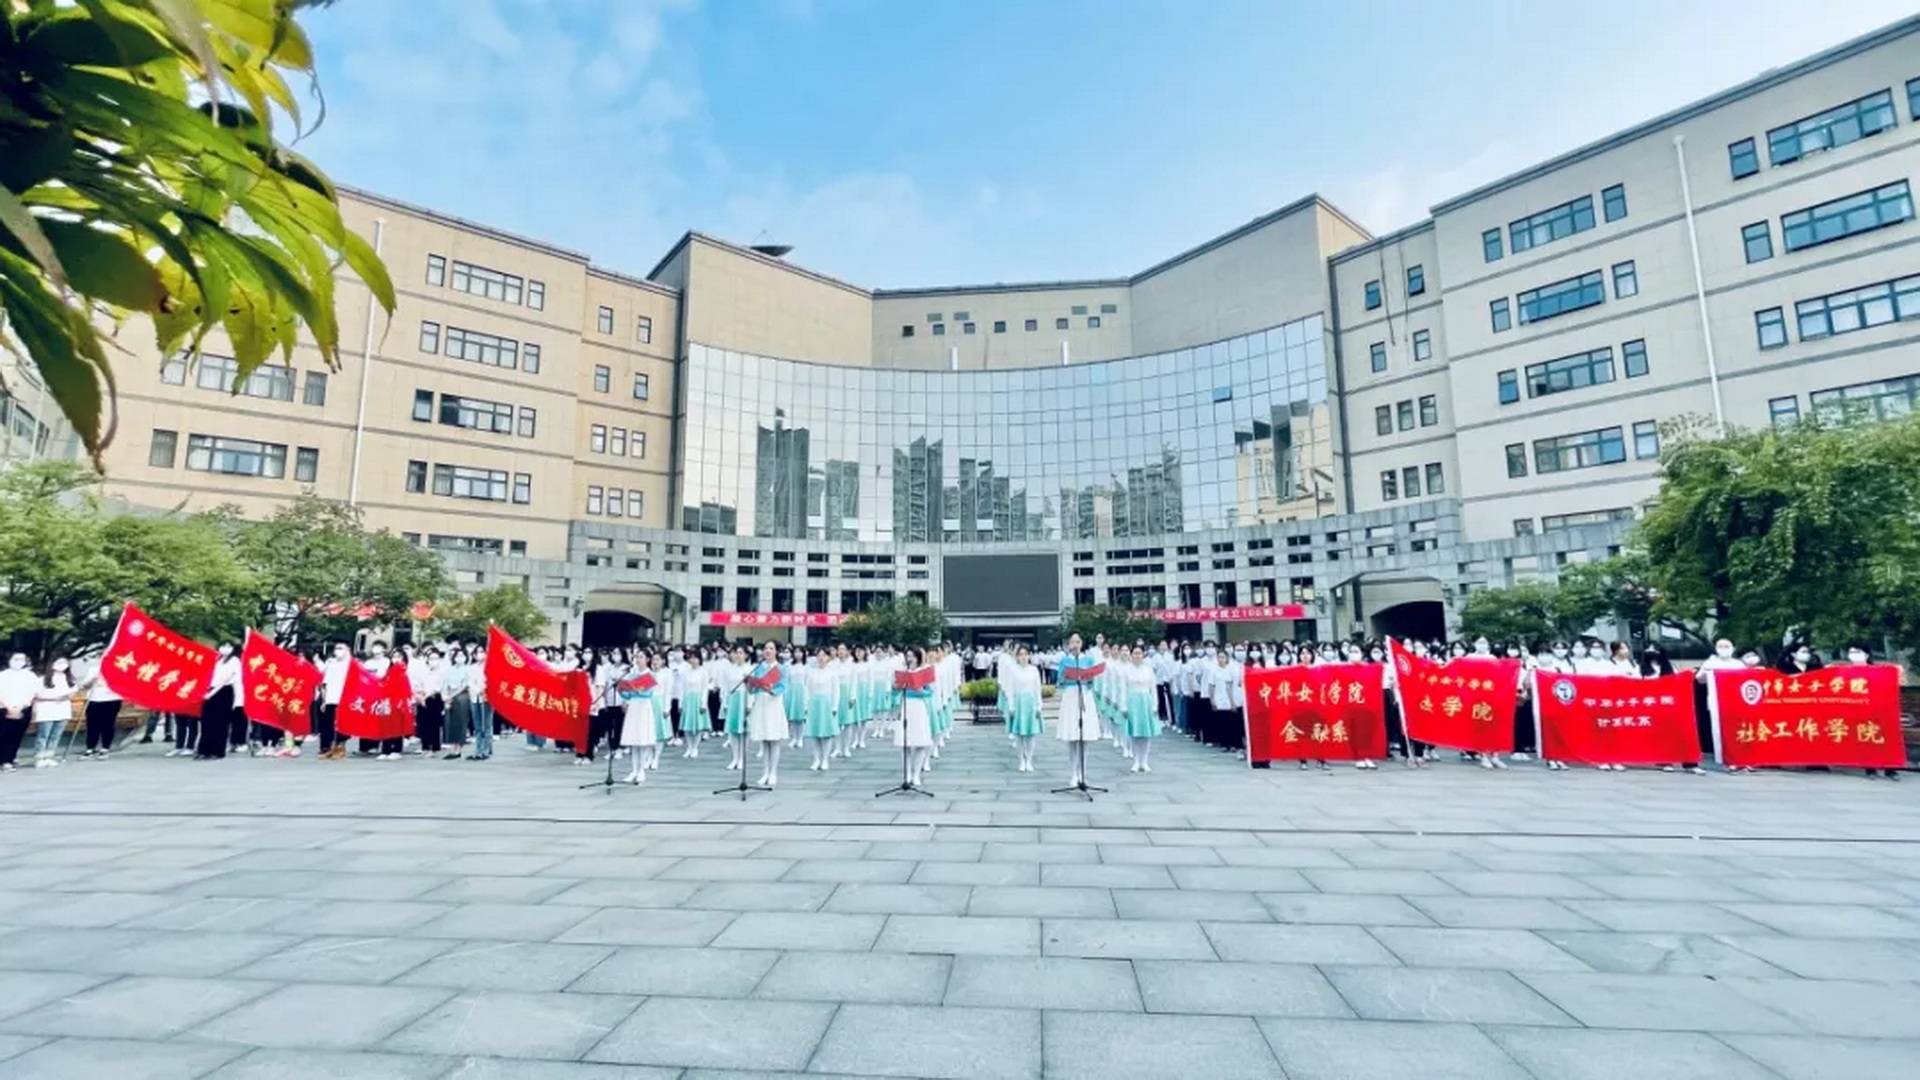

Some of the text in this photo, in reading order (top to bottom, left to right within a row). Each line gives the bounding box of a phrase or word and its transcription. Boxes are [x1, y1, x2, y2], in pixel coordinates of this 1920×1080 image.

[1280, 719, 1349, 743] 金融系
[1736, 717, 1885, 744] 社会工作学院
